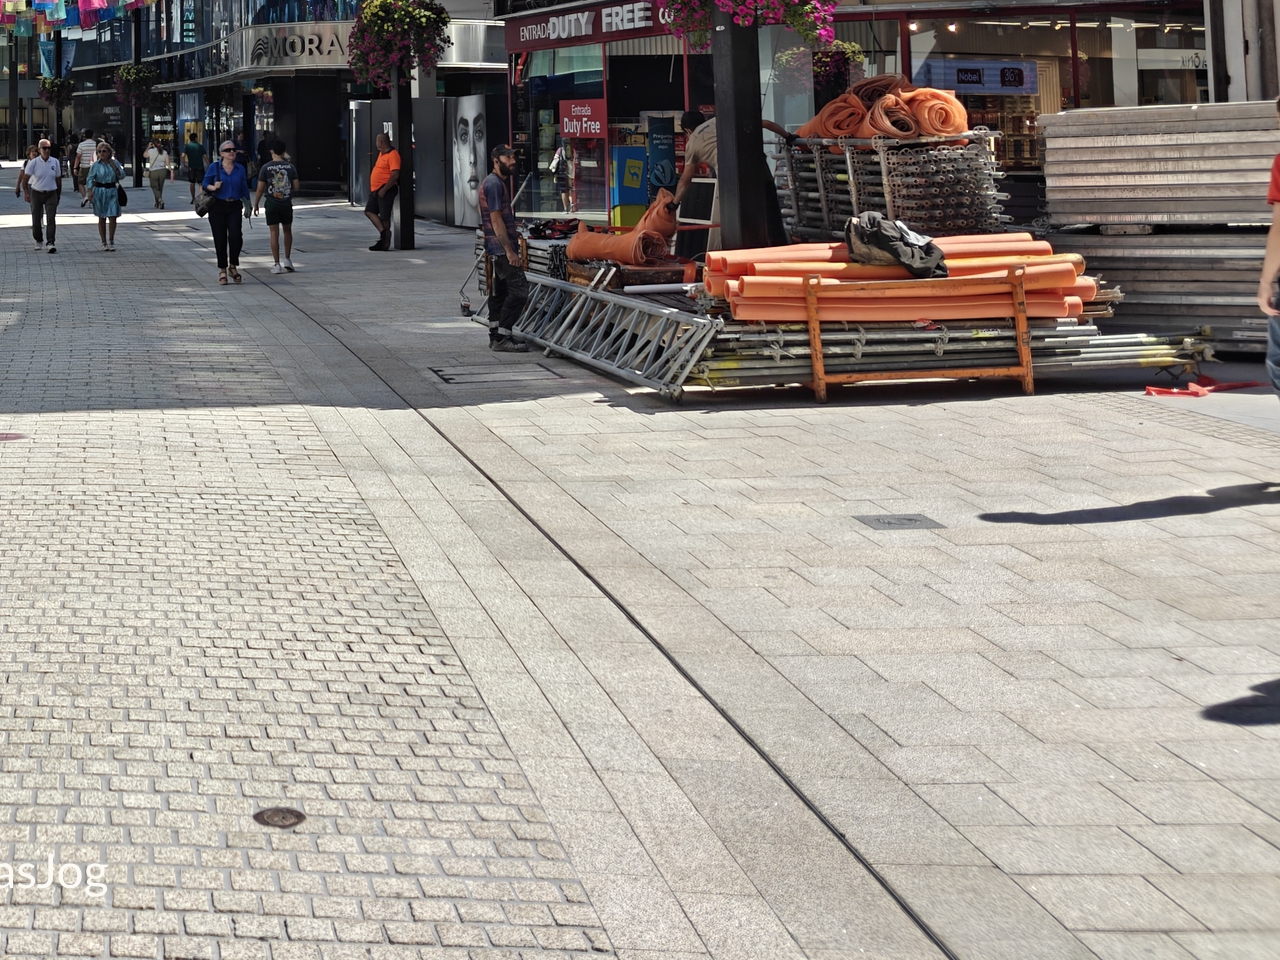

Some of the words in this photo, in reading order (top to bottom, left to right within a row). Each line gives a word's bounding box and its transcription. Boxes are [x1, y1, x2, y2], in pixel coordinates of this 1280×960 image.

[520, 22, 552, 41] ENTRADA
[549, 11, 595, 39] DUTY
[601, 1, 653, 33] FREE
[958, 71, 980, 82] Nobel
[571, 104, 591, 116] Entrada
[563, 118, 581, 137] Duty
[582, 118, 601, 134] Free
